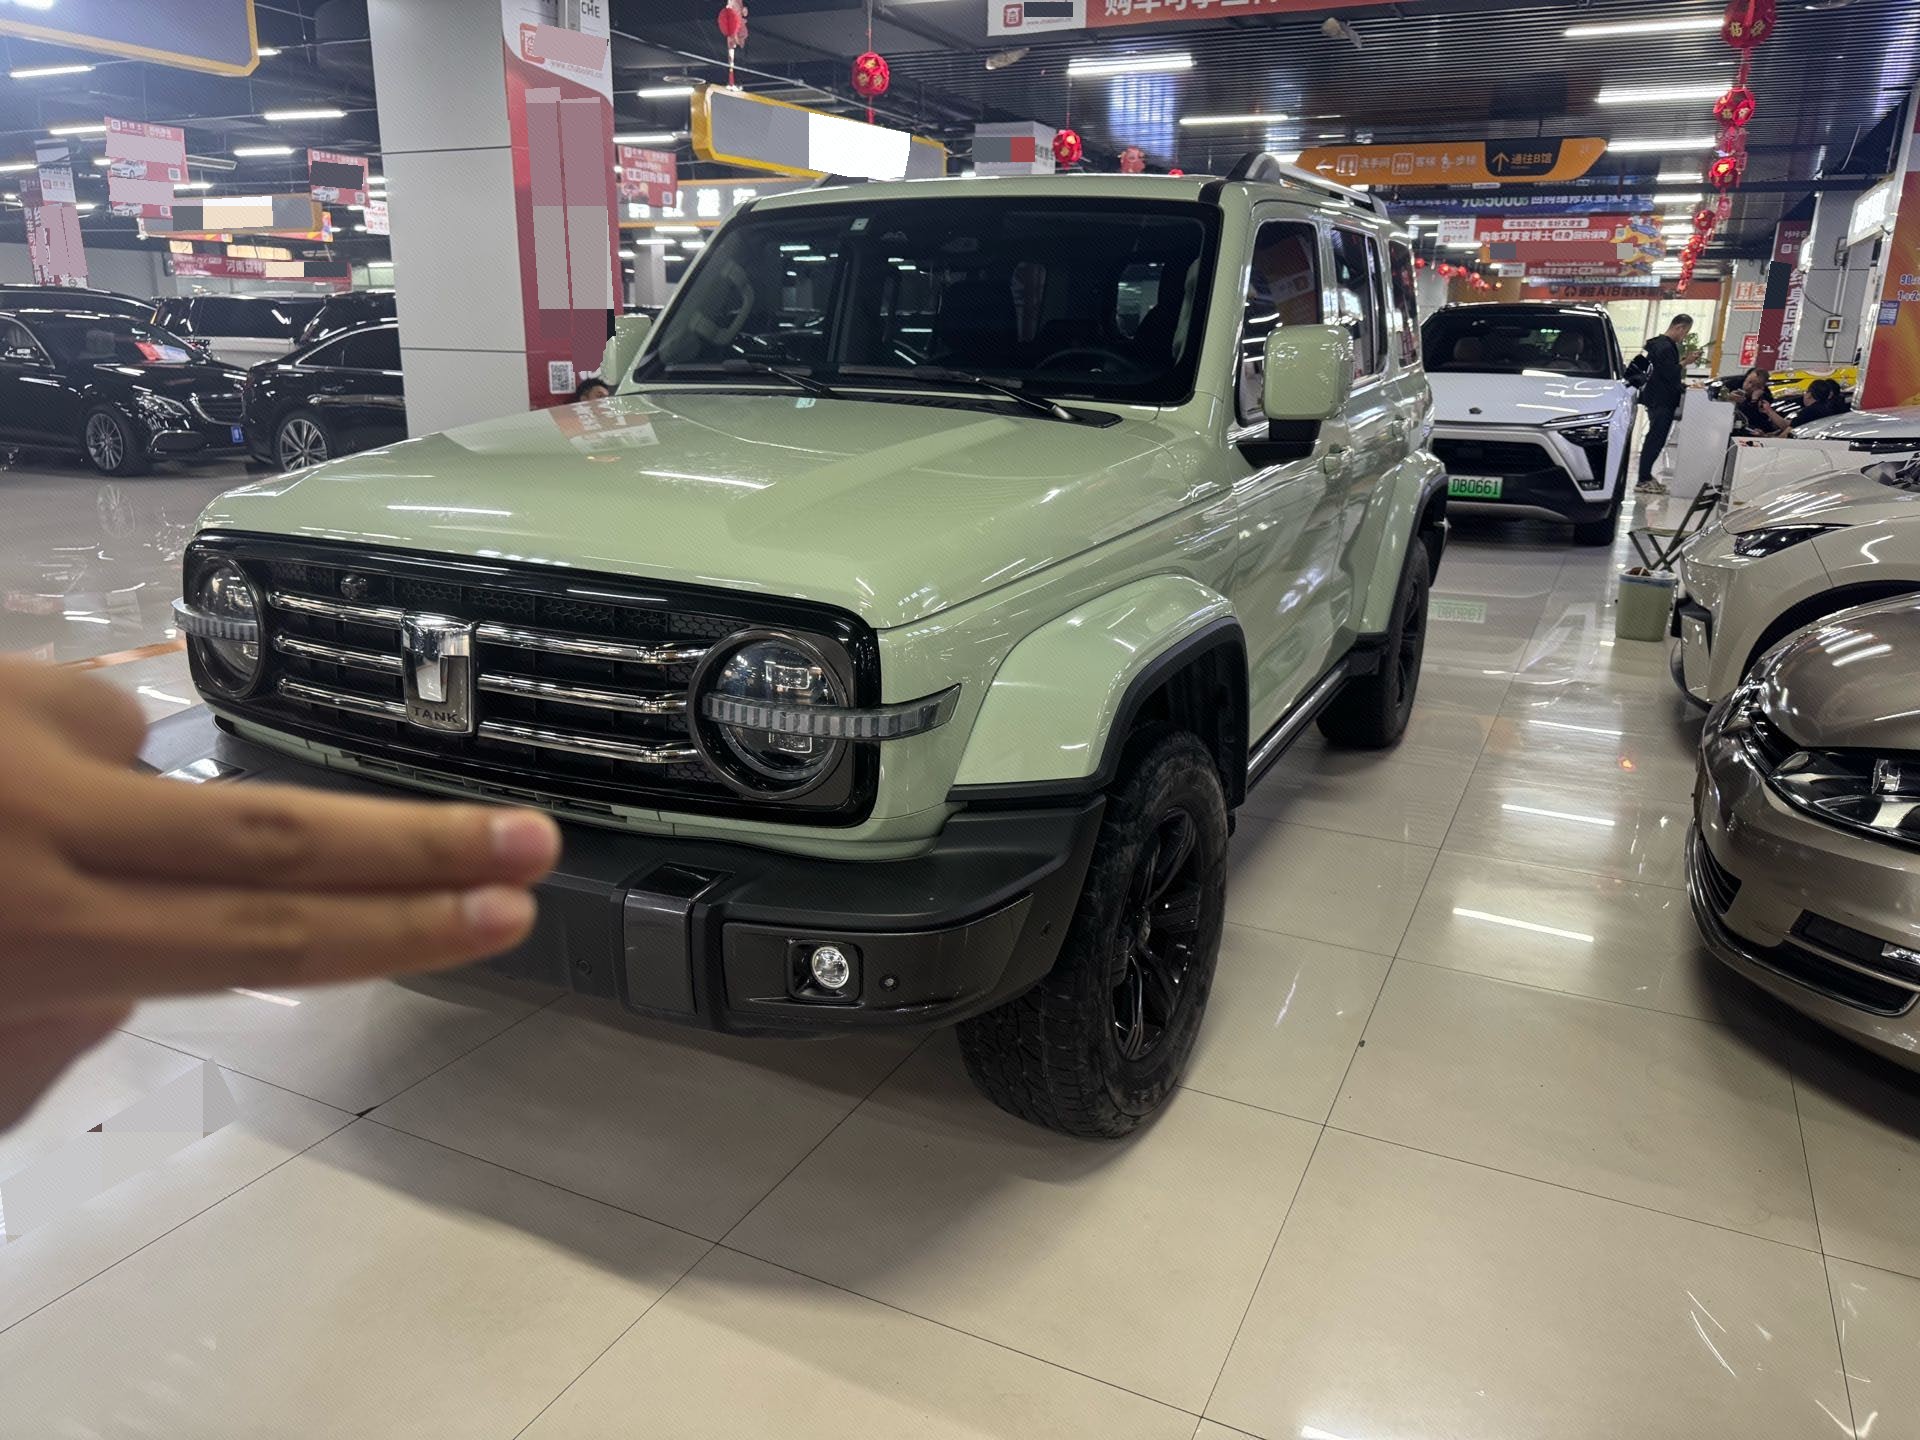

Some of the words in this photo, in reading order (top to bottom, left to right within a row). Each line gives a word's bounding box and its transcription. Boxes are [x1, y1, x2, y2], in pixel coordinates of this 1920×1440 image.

[1511, 153, 1552, 164] 通往B馆
[413, 707, 458, 723] TANK
